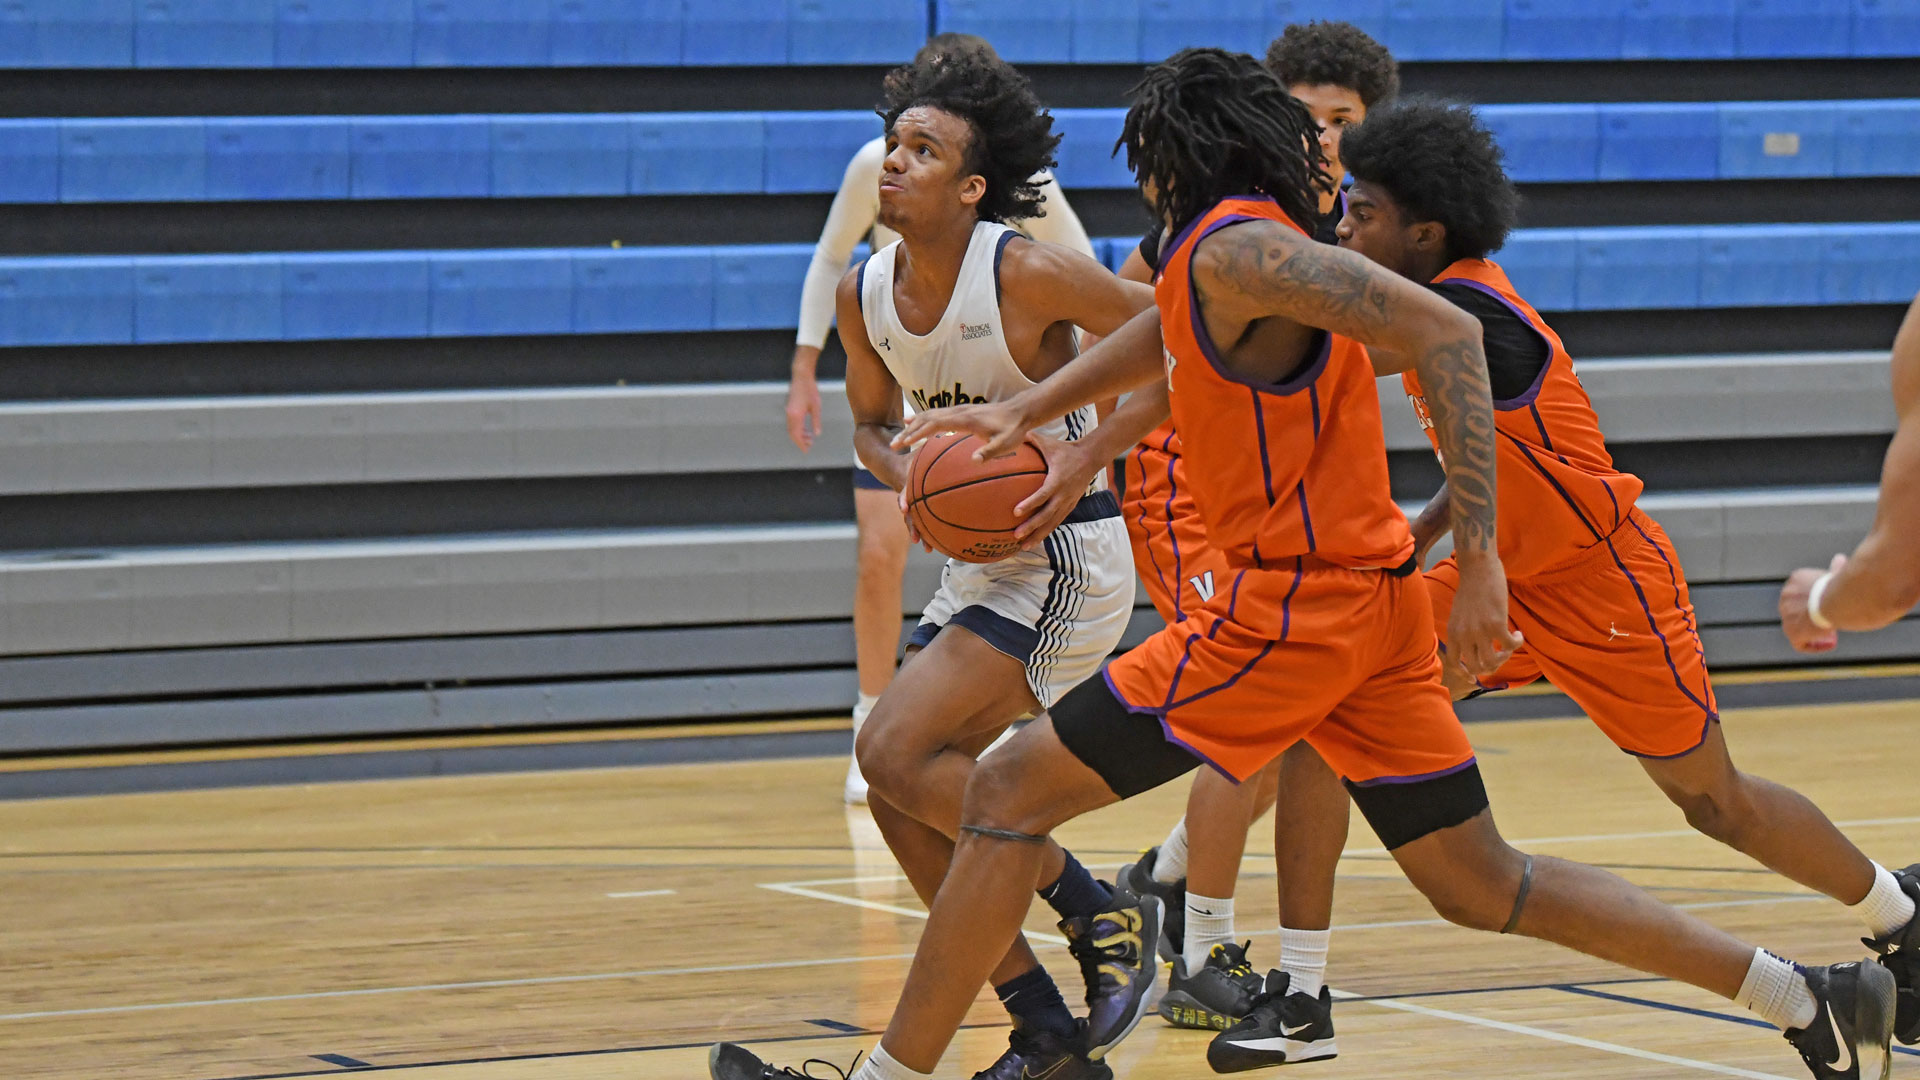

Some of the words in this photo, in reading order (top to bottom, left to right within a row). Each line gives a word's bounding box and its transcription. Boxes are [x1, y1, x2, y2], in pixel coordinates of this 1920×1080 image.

[961, 329, 993, 341] ASSOCIATES
[965, 323, 991, 332] MEDICAL
[1189, 570, 1216, 602] V
[1171, 1006, 1208, 1027] THE
